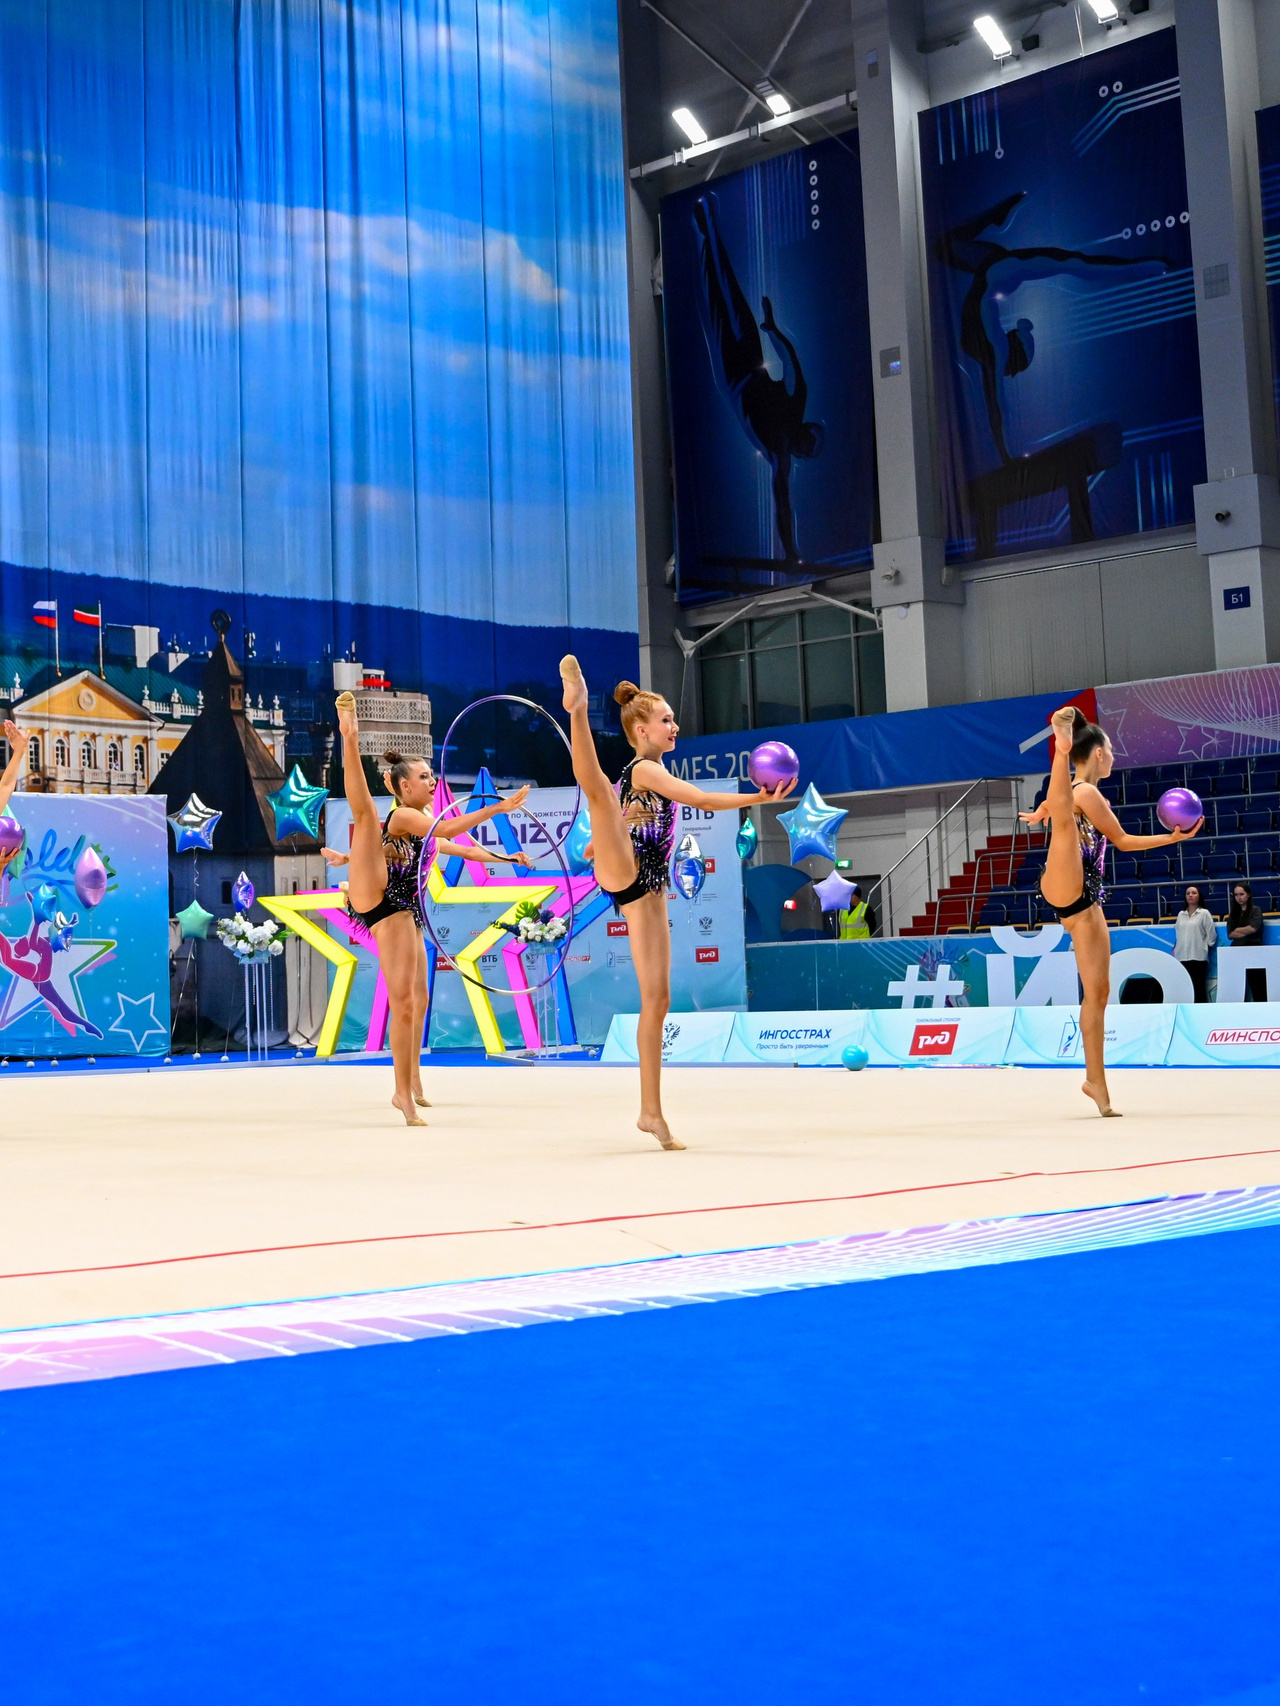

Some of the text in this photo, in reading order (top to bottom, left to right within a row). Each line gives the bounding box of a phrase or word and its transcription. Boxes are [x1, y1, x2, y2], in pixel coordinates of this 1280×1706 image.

[670, 751, 751, 782] MES 20
[481, 954, 498, 963] ВТБ
[759, 1028, 832, 1040] ИНГОССТРАХ
